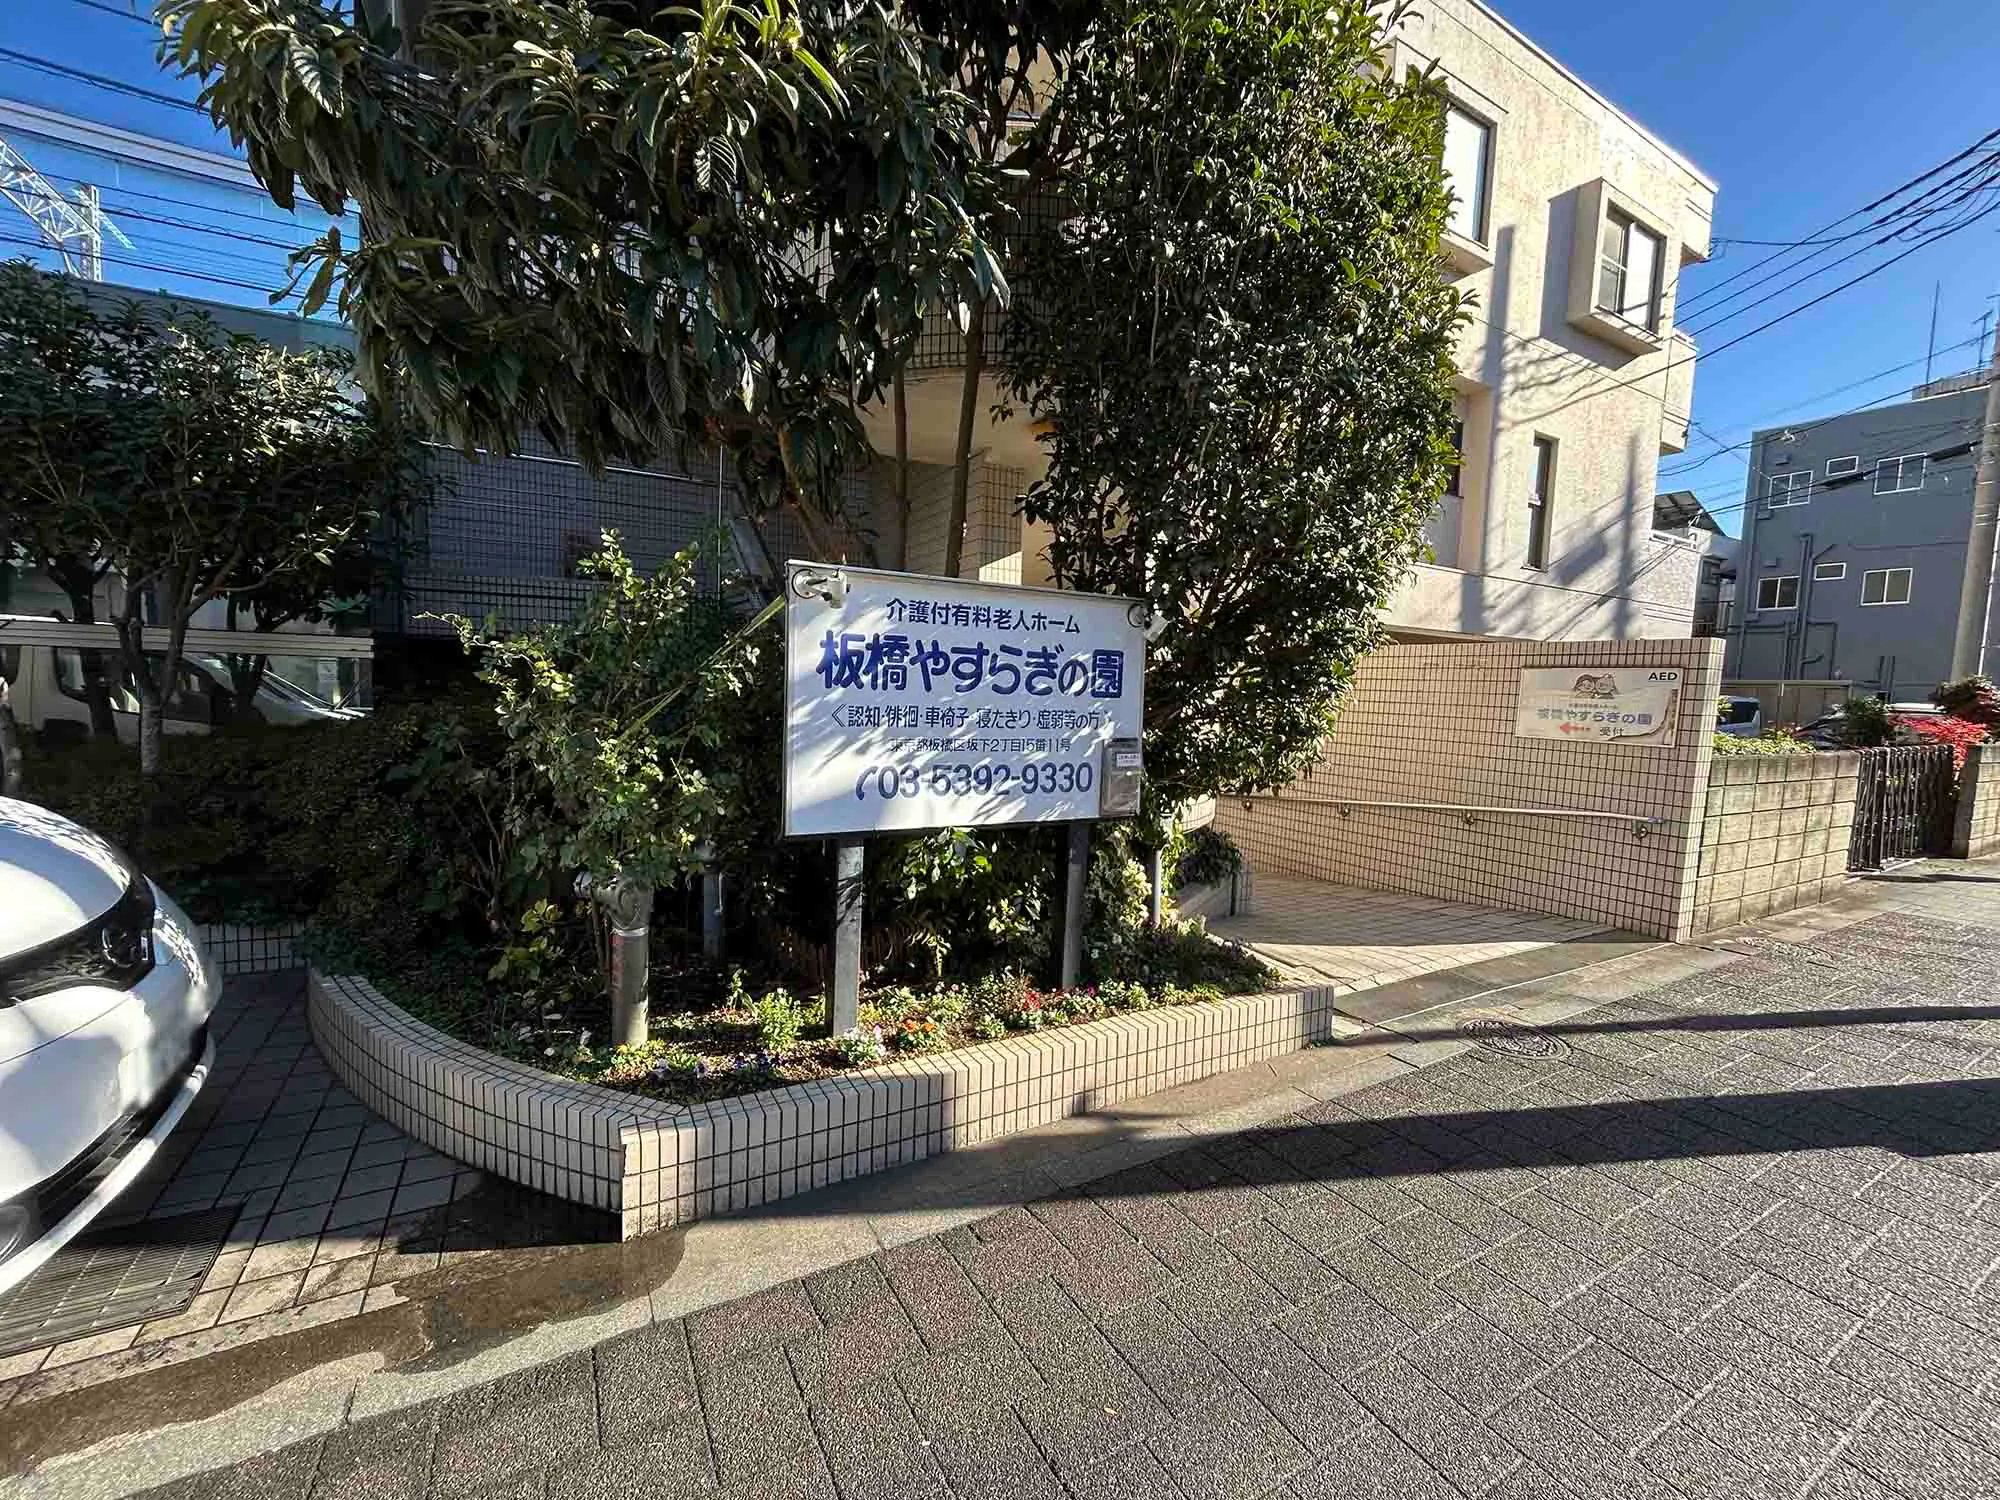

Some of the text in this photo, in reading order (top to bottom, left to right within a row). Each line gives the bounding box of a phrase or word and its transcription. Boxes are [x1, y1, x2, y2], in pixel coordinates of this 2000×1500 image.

[886, 598, 1080, 634] 介護付有料老人ホーム
[815, 630, 1125, 699] 板橋やすらぎの園
[1648, 672, 1678, 681] AED
[877, 761, 1094, 800] 03-5392-9330
